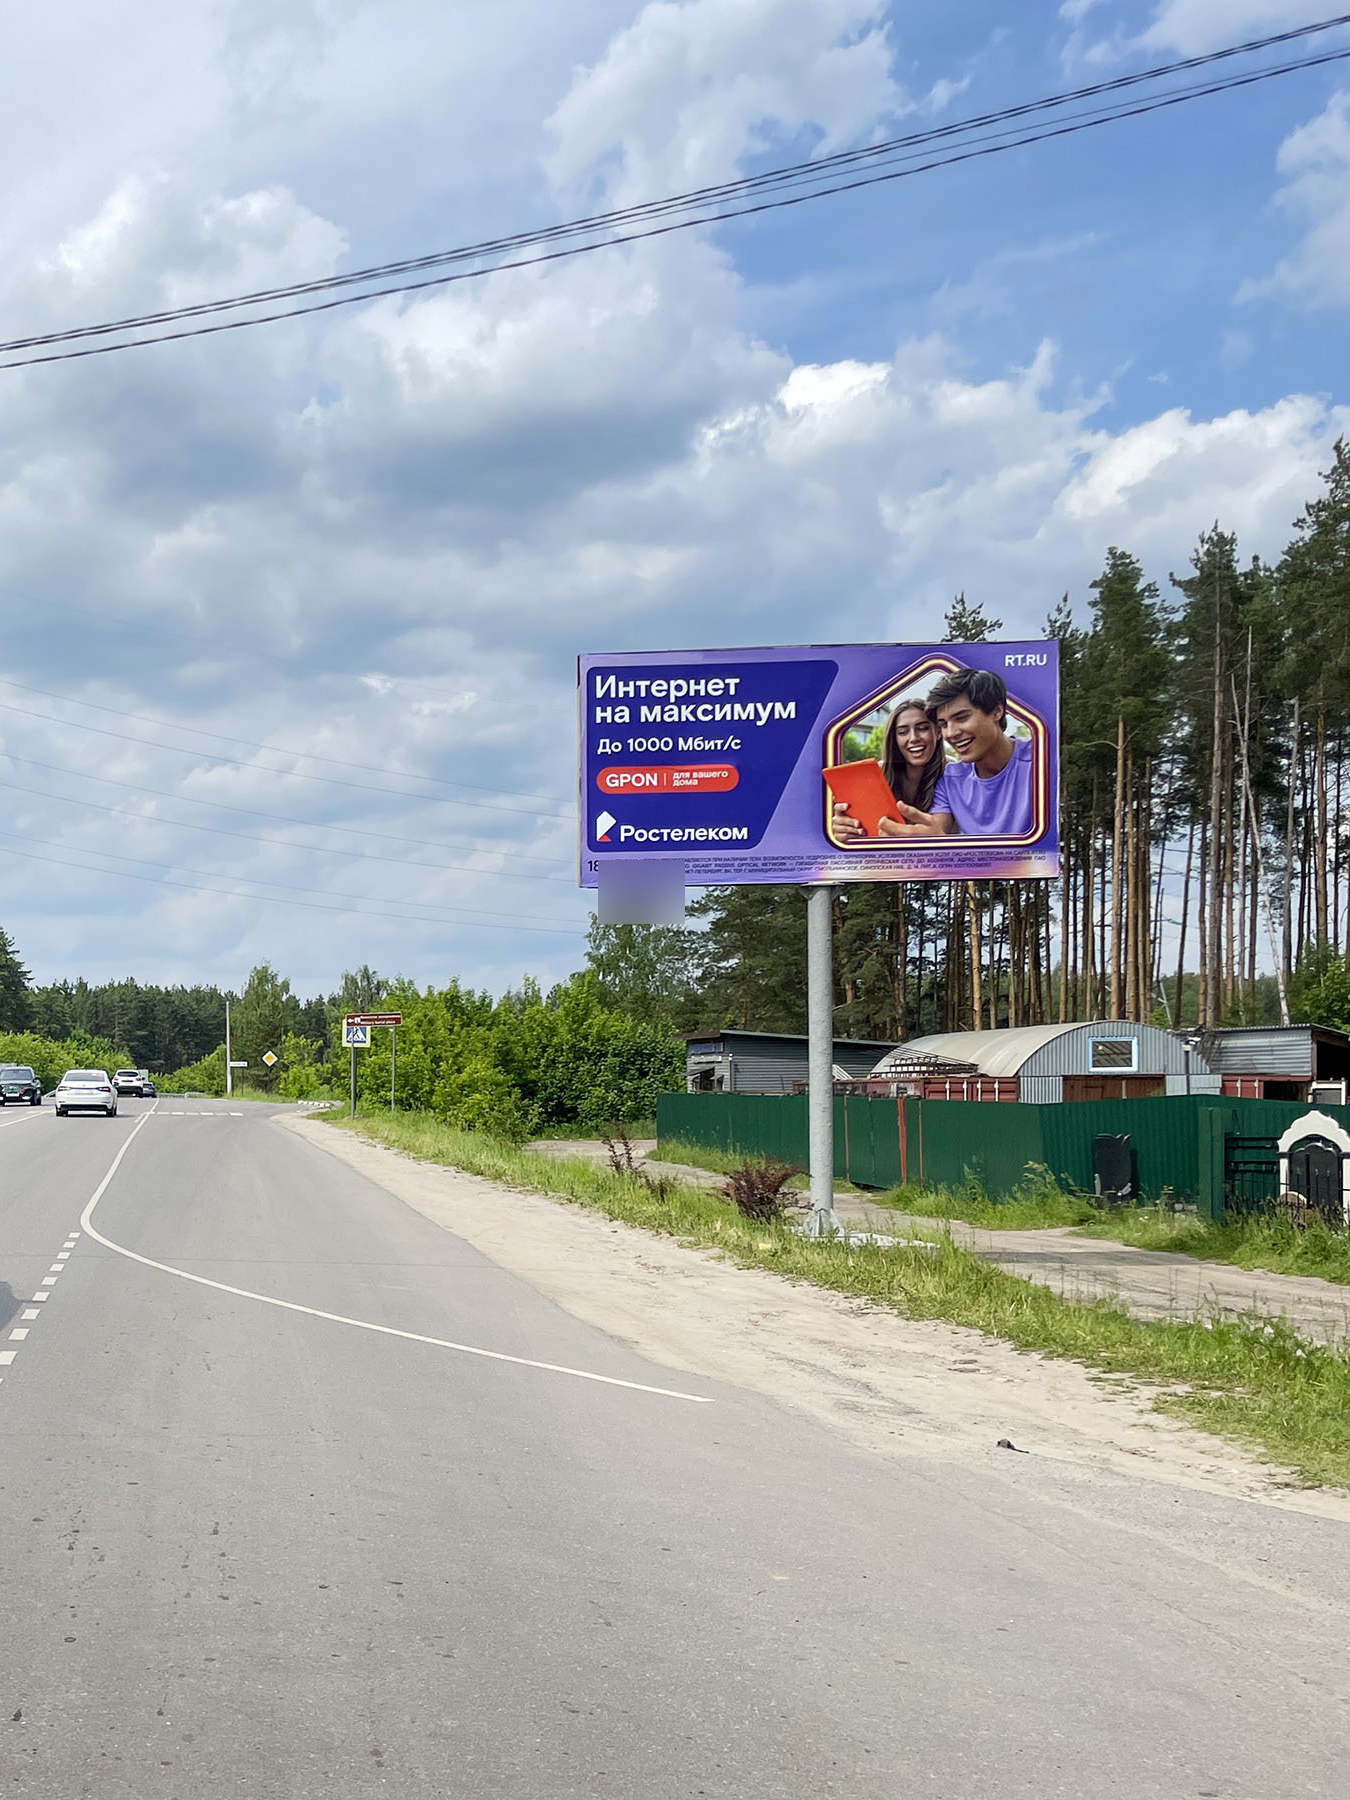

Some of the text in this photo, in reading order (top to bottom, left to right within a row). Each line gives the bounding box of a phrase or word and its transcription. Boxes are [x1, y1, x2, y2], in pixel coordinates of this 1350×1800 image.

[1005, 653, 1047, 667] RT.RU
[595, 674, 740, 703] Интернет
[595, 701, 796, 727] на максимум
[597, 735, 742, 755] До 1000 Мбит/с
[605, 773, 658, 788] GPON
[672, 770, 729, 780] для вашего
[672, 779, 699, 788] дома
[620, 825, 749, 842] Ростелеком
